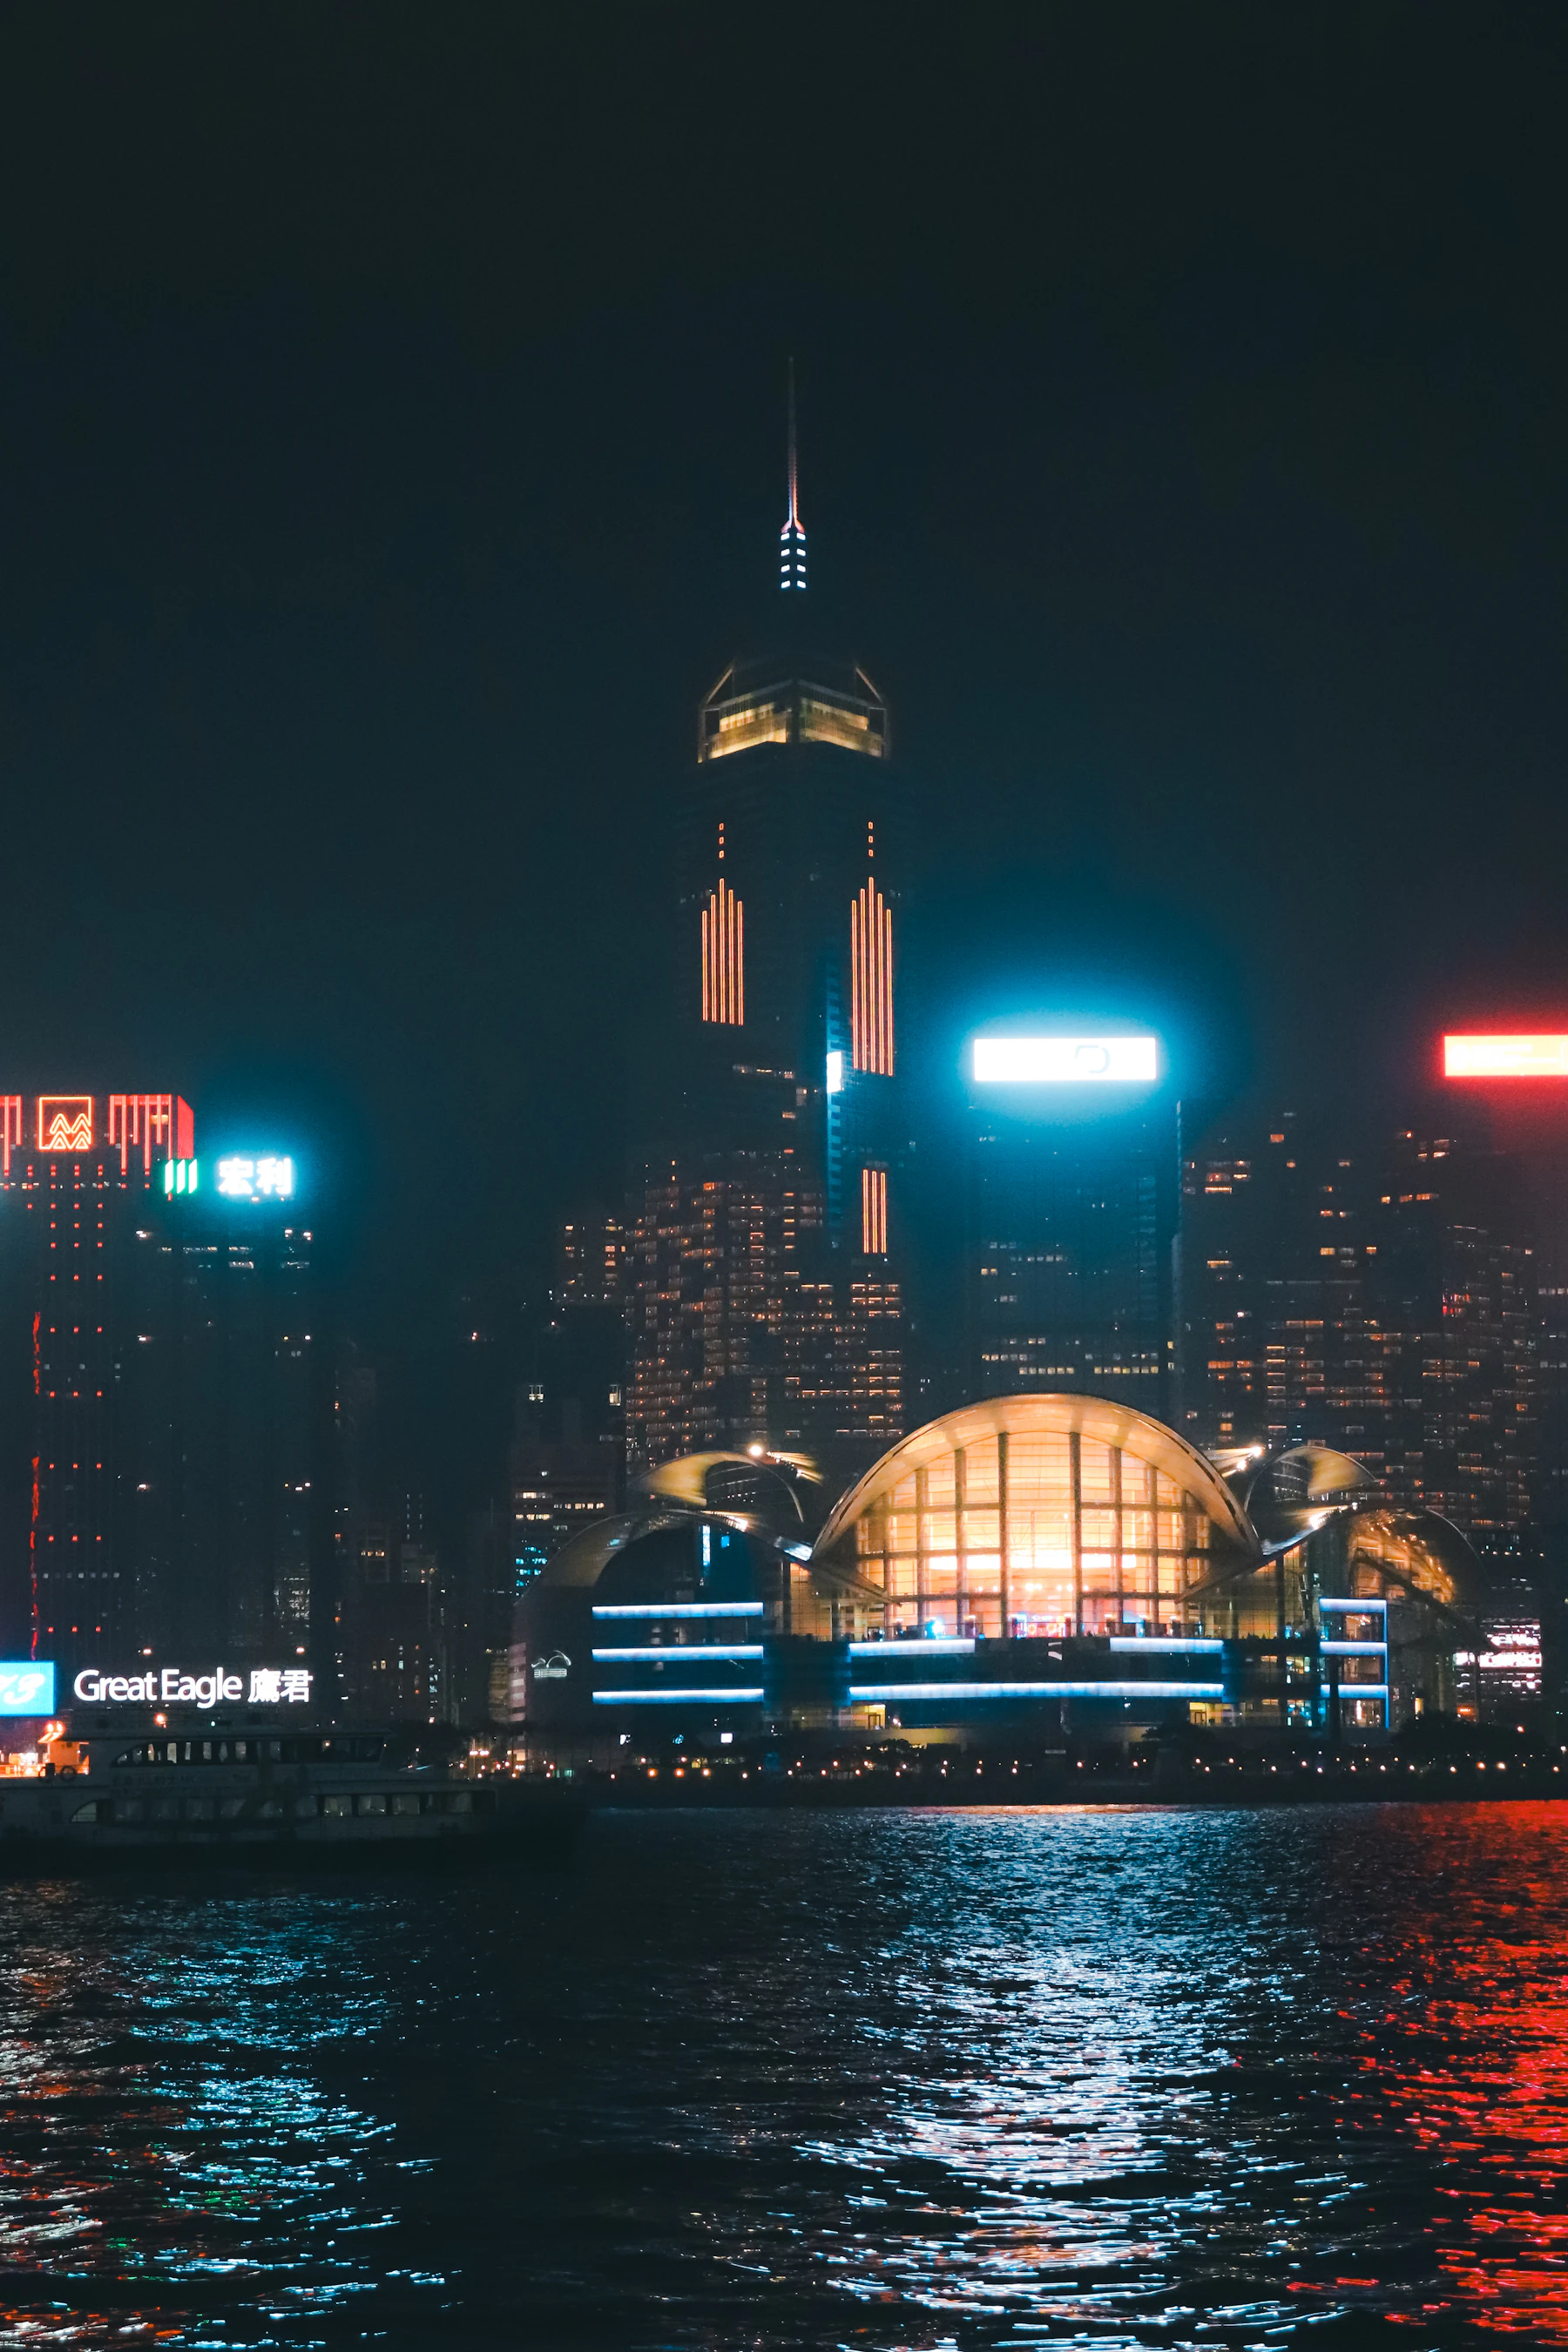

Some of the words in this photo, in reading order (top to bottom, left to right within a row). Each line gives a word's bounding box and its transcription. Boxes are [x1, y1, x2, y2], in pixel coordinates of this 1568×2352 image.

[219, 1157, 292, 1194] 宏利
[73, 1669, 158, 1700] Great
[161, 1666, 243, 1709] Eagle
[247, 1668, 314, 1703] 鷹君
